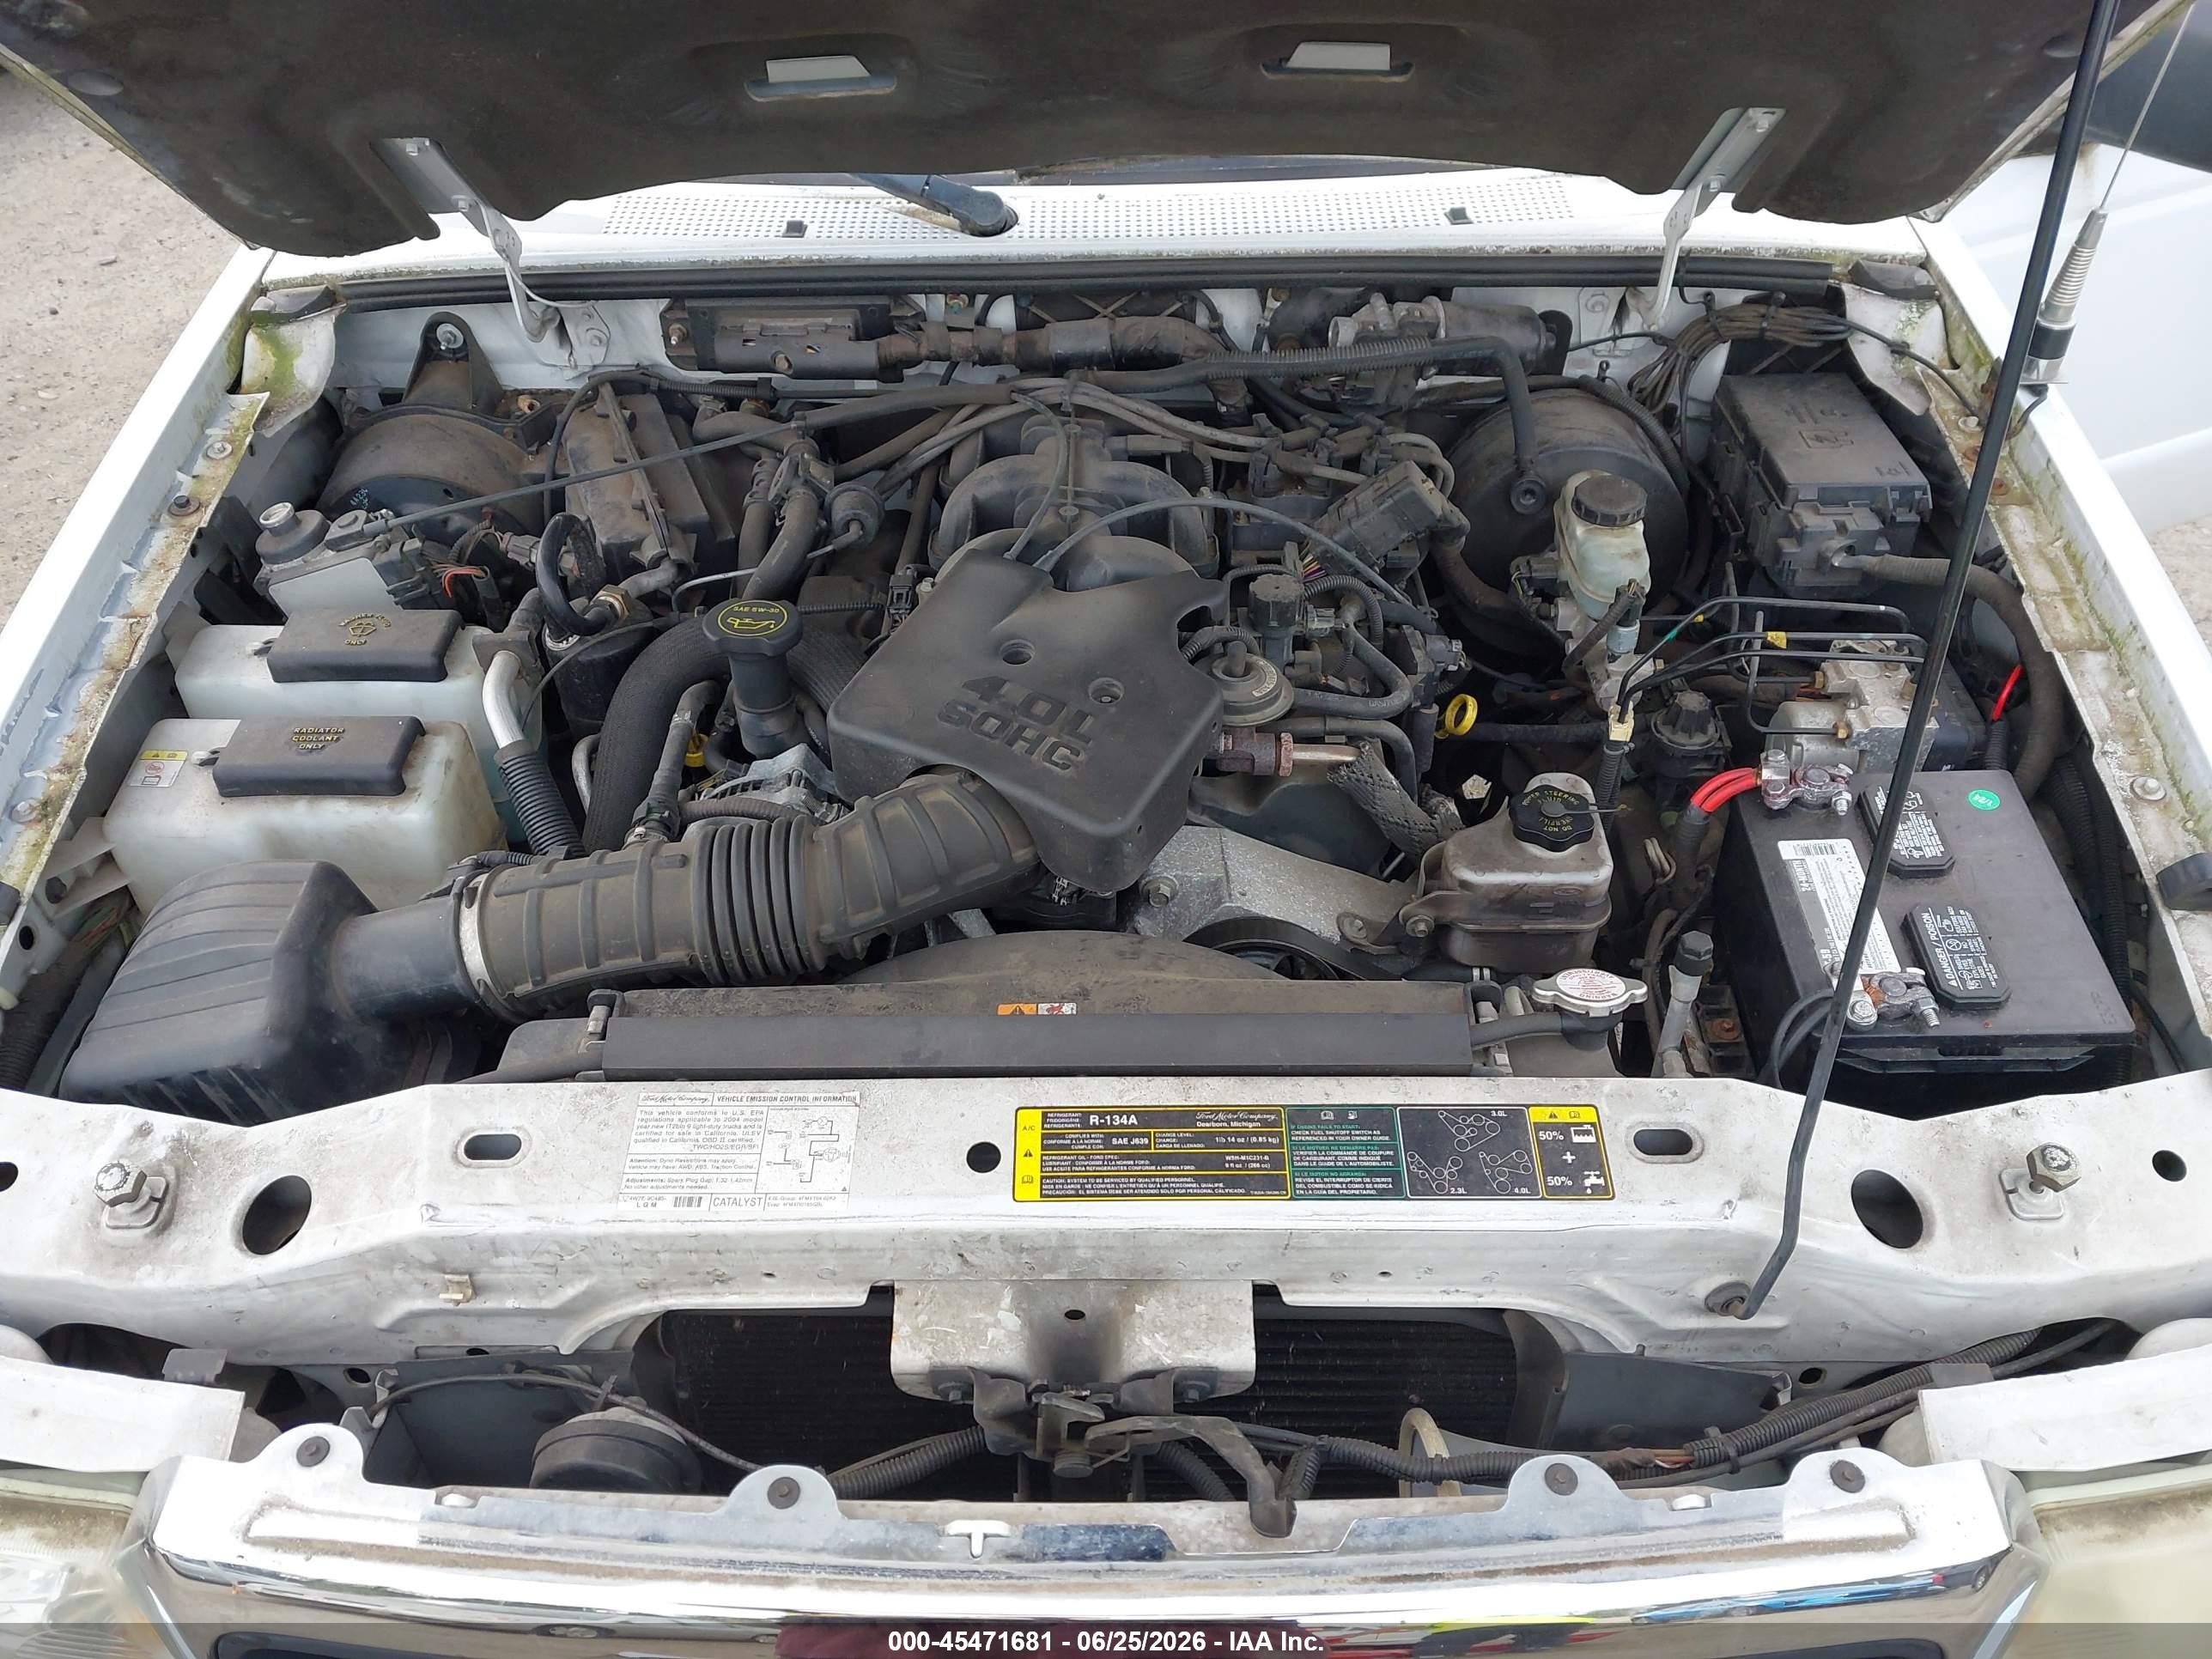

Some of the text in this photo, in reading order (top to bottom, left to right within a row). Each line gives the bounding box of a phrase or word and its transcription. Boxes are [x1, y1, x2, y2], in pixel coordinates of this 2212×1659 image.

[936, 698, 1086, 771] SOHC
[1544, 790, 1580, 805] STEERING
[1921, 912, 1940, 941] POISON
[1935, 947, 1955, 980] DANGER
[1089, 1115, 1138, 1126] R-134A
[1195, 1110, 1238, 1121] Ford Motor
[1538, 1130, 1565, 1141] 50%
[1546, 1176, 1573, 1187] 50%
[713, 1196, 763, 1207] CATALYST
